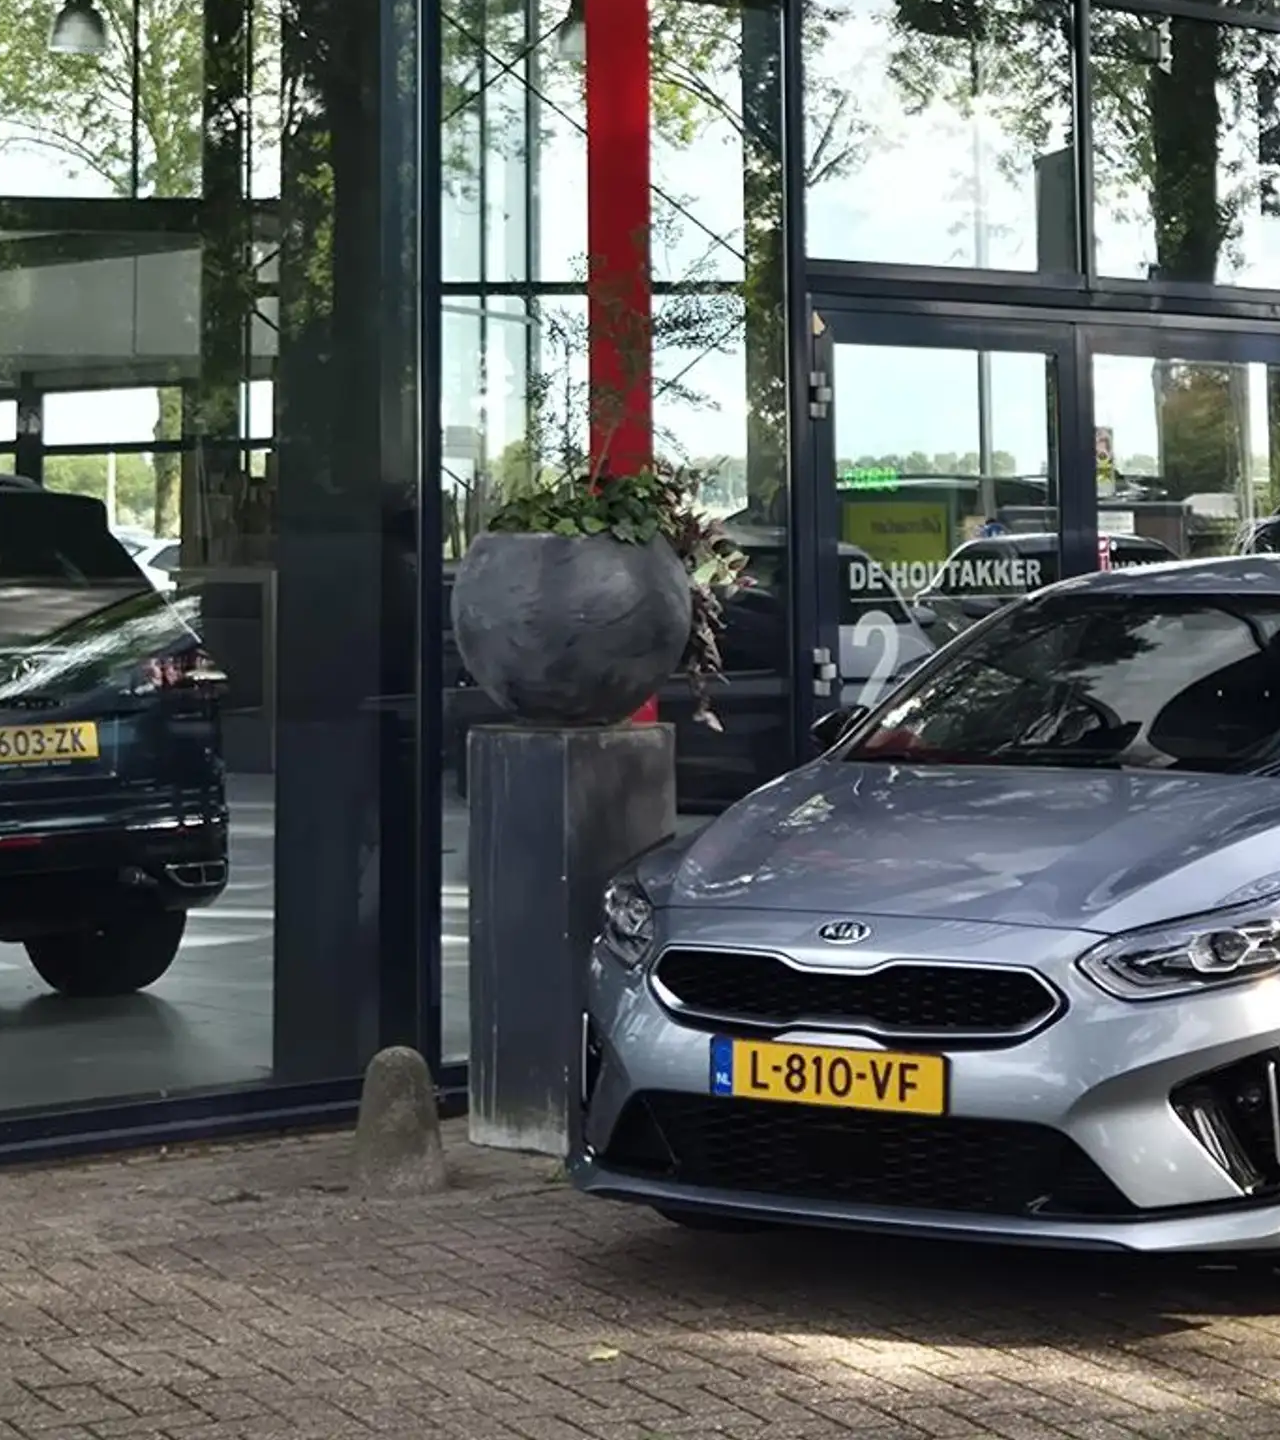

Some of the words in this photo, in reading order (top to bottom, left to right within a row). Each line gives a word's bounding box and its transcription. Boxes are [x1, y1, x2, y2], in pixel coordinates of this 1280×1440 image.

[849, 562, 884, 590] DE
[892, 559, 1042, 589] HOUTAKKER
[823, 922, 863, 941] KIA
[716, 1071, 731, 1086] NL
[750, 1050, 920, 1103] L-810-VF
